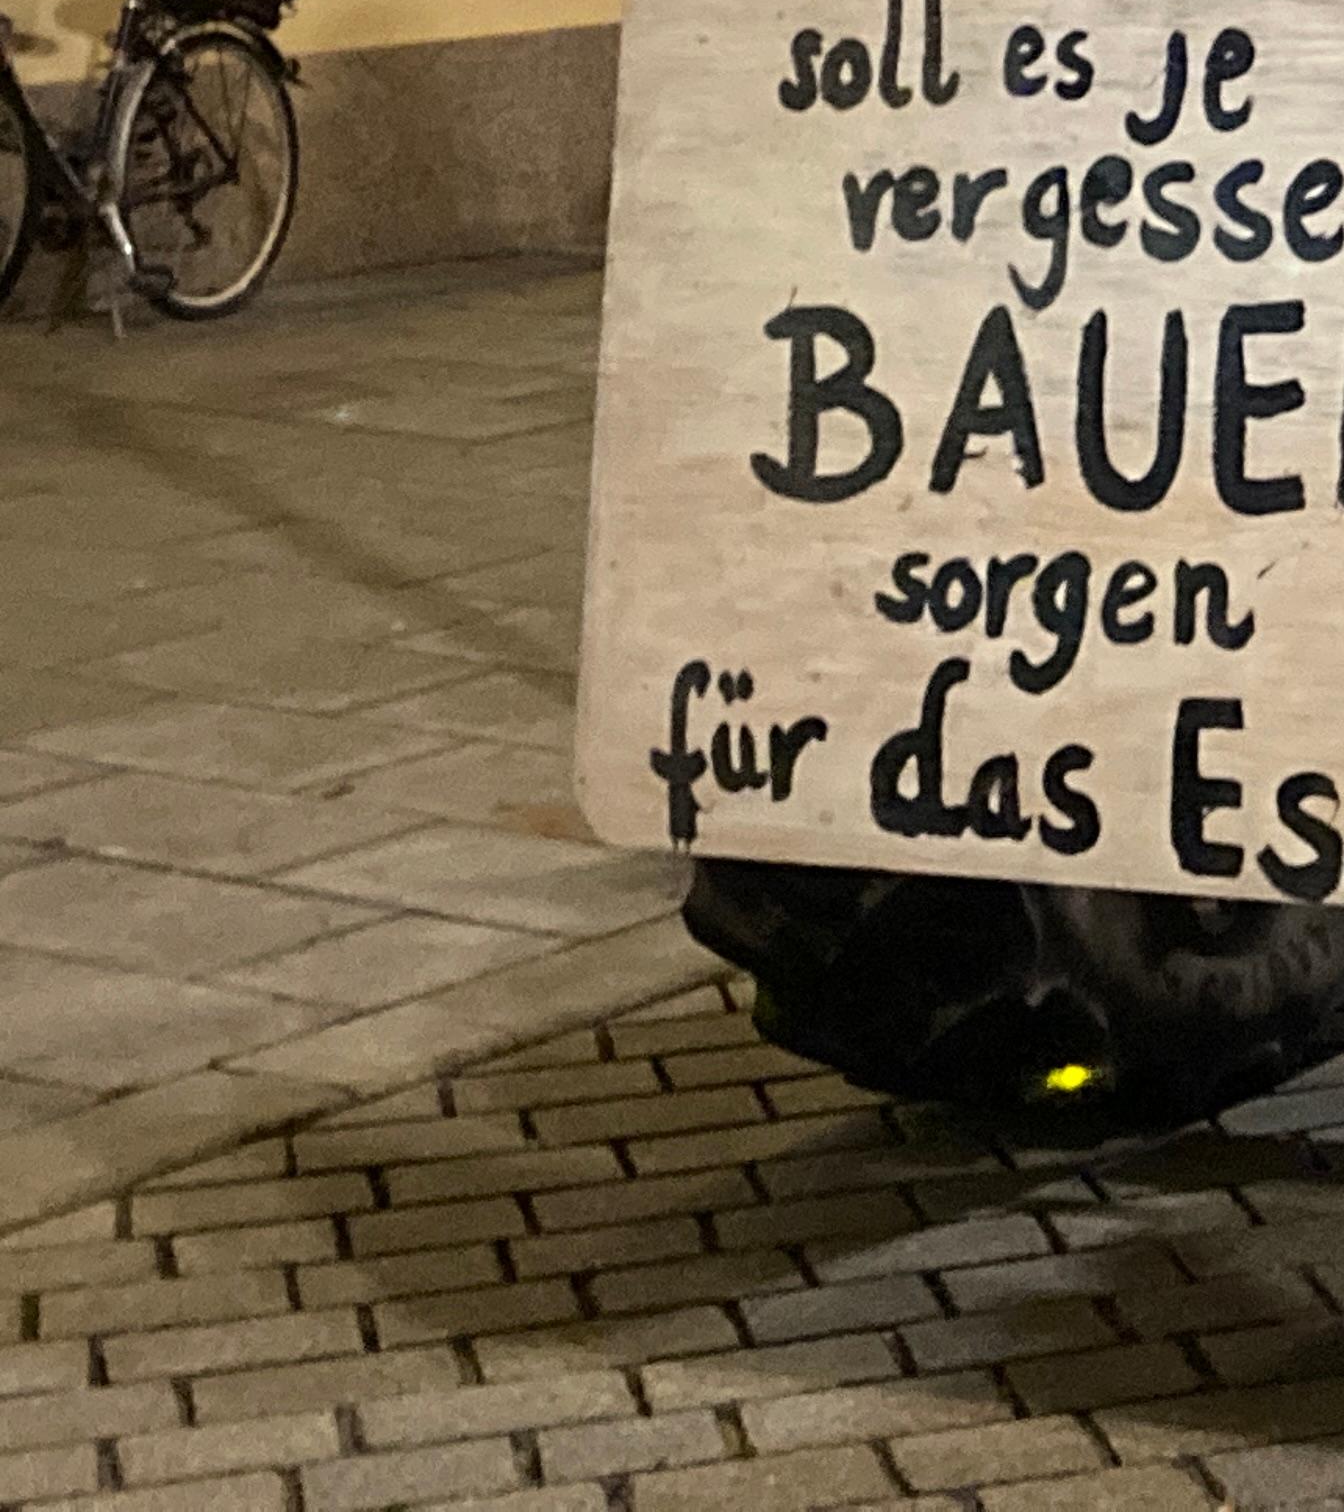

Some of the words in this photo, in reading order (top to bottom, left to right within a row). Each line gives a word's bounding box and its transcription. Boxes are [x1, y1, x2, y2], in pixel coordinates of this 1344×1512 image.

[1004, 25, 1094, 102] es
[874, 550, 1256, 695] sorgen
[650, 659, 828, 848] für
[870, 657, 1102, 856] das
